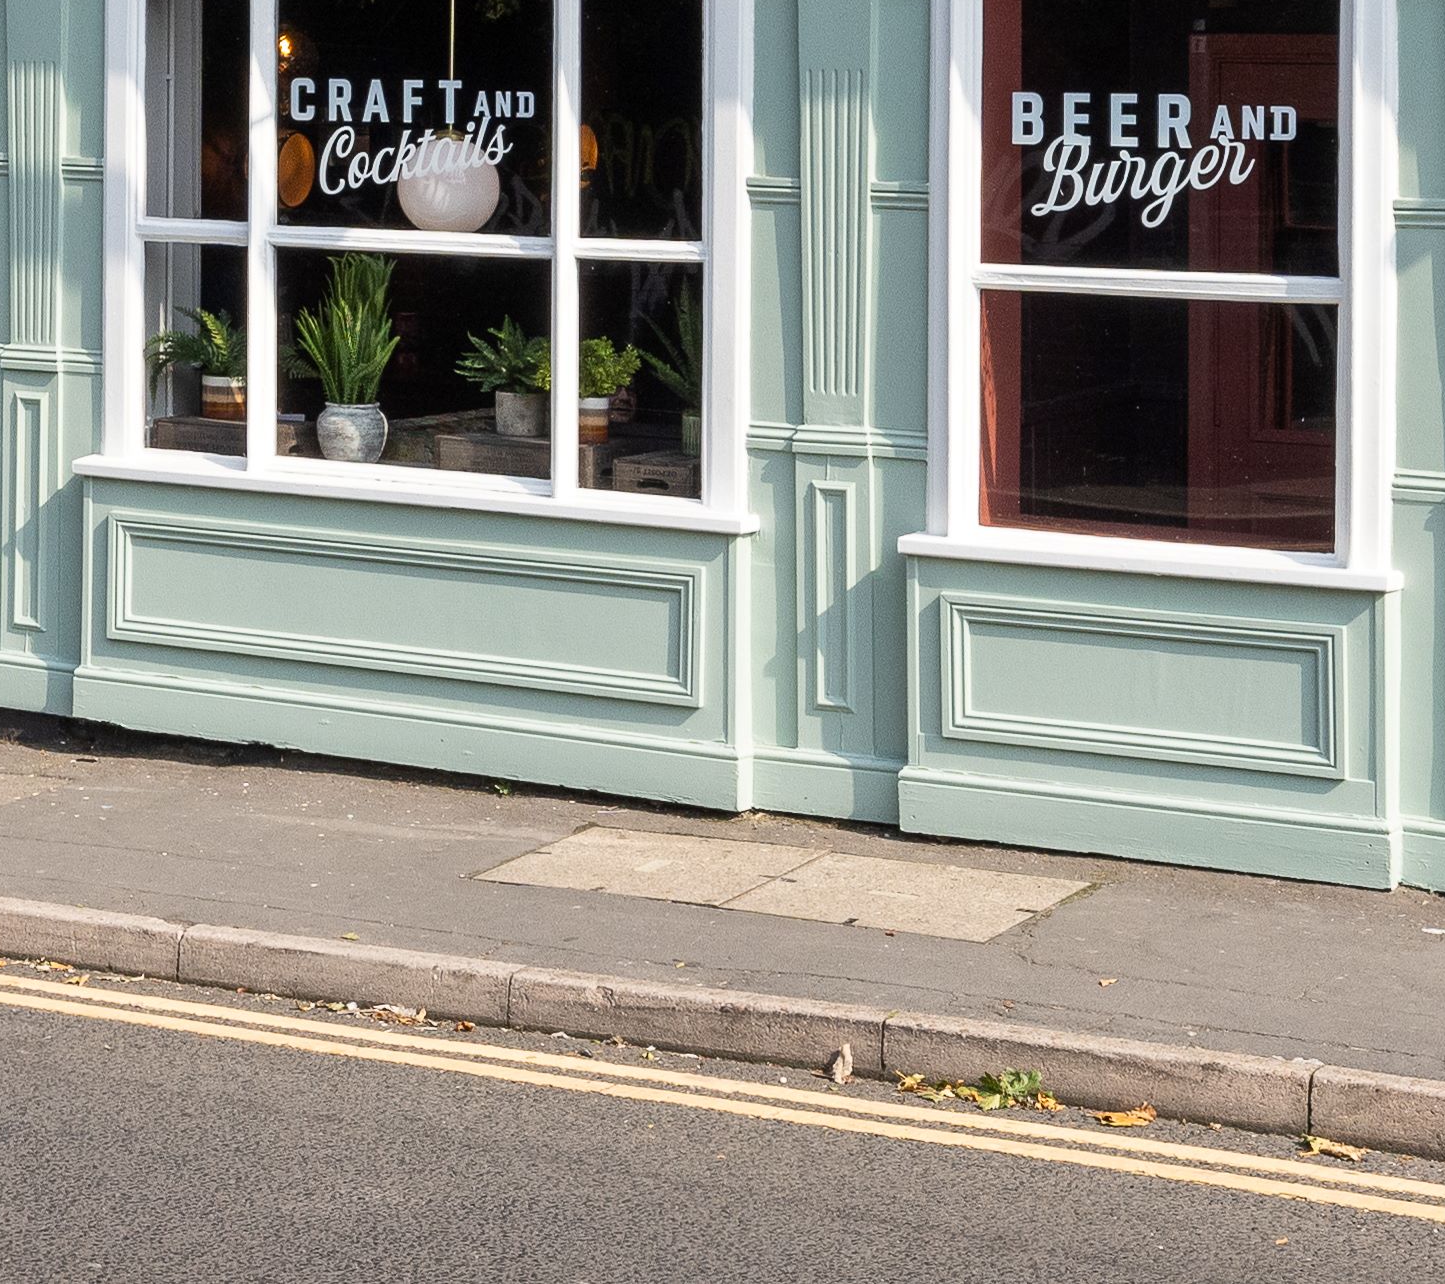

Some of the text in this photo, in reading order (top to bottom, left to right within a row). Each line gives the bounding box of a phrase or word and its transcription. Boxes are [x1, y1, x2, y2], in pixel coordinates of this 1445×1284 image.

[290, 77, 535, 125] CRAFT AND
[1011, 91, 1298, 149] BEER AND
[319, 114, 514, 195] Cocktails
[1031, 133, 1256, 228] Burger
